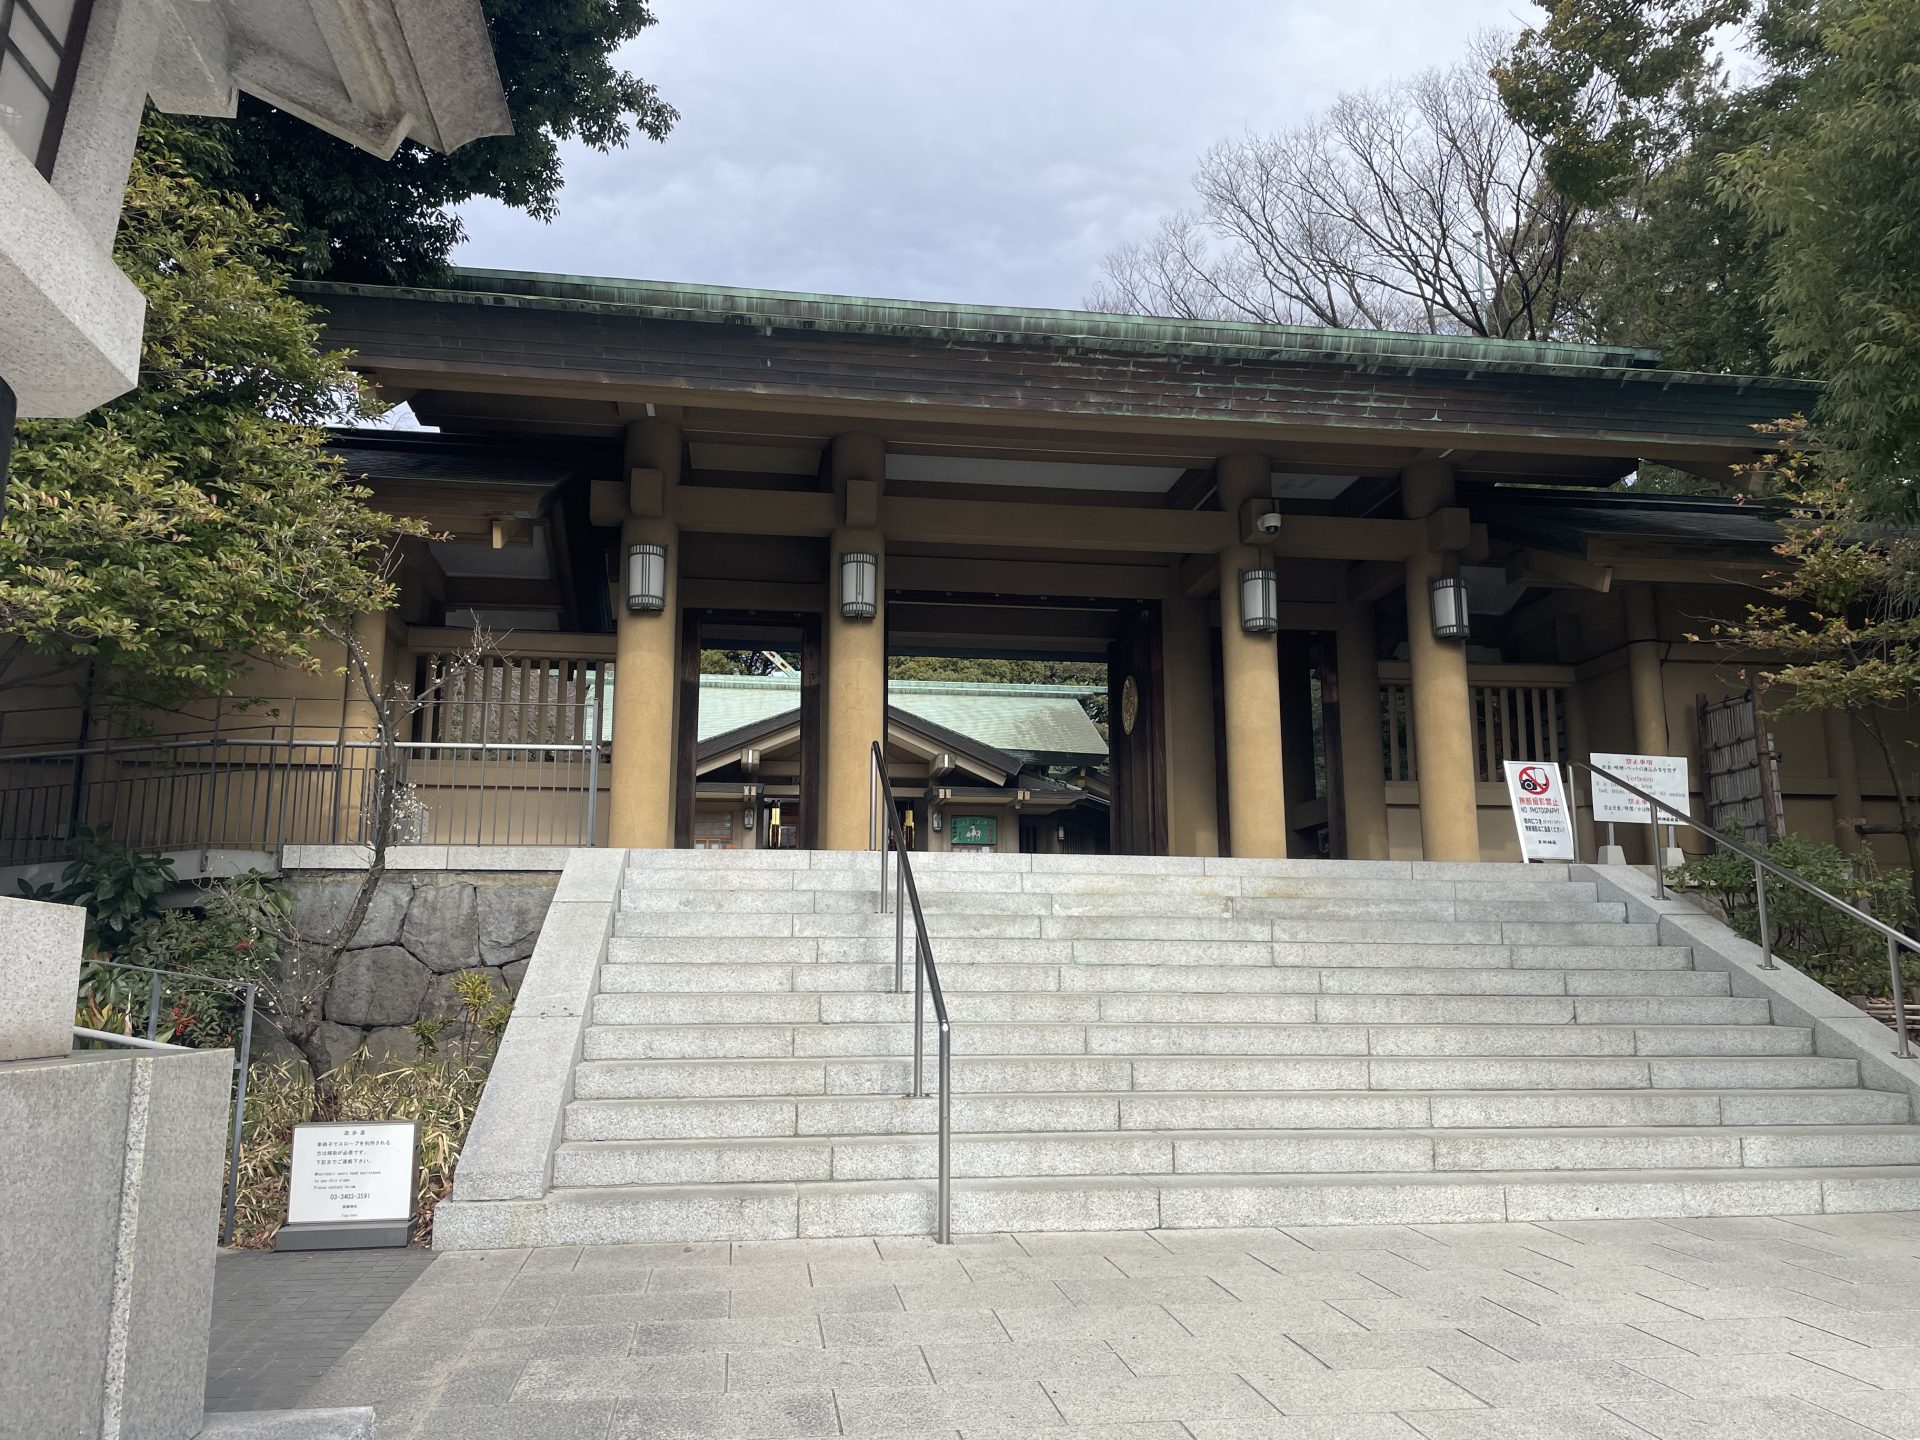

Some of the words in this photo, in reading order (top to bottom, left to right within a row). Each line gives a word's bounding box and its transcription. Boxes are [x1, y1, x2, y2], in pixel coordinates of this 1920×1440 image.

[1626, 775, 1654, 783] Verboten
[1519, 797, 1559, 807] 無断撮影禁止
